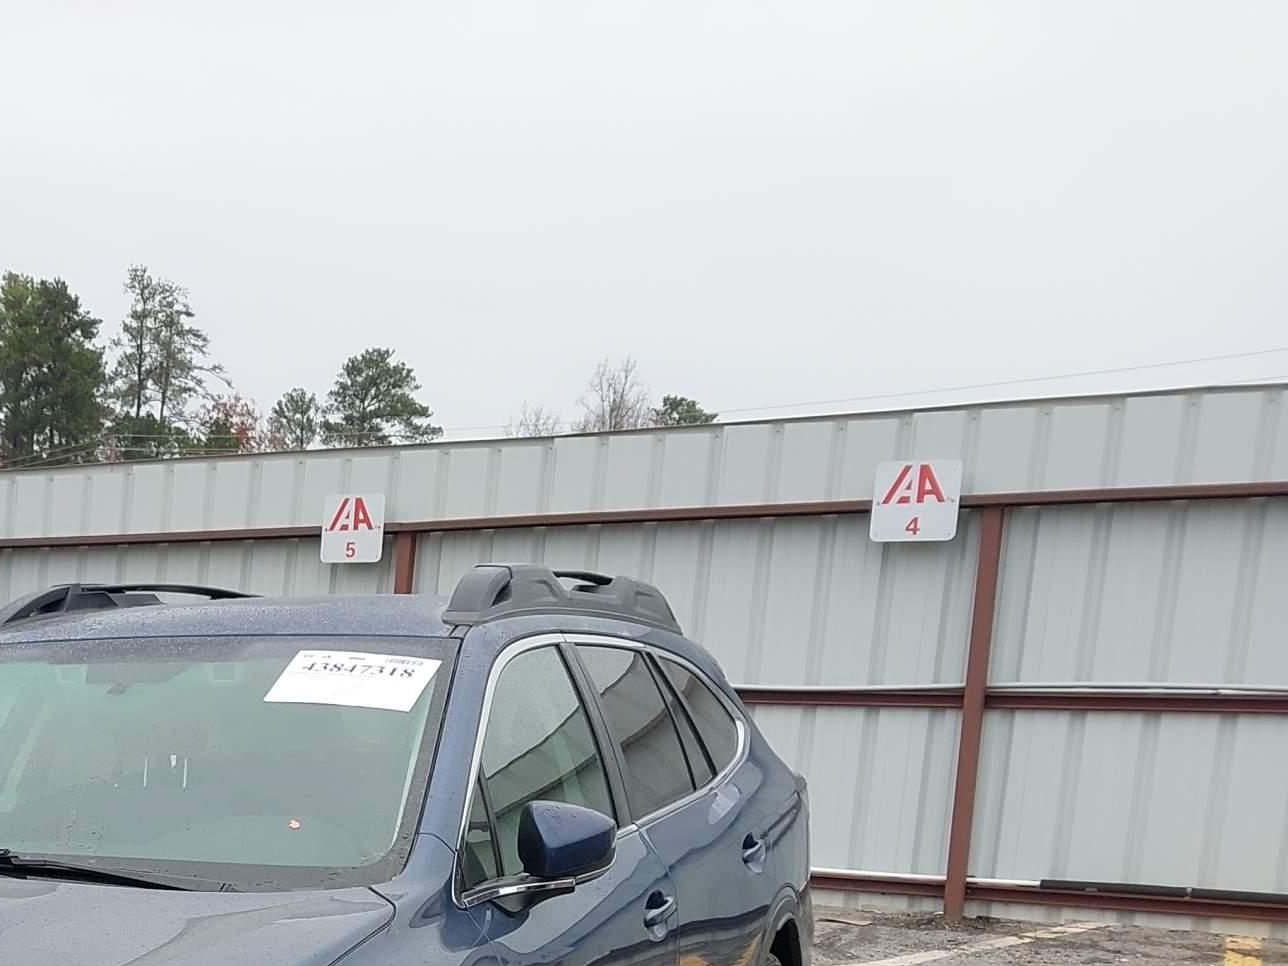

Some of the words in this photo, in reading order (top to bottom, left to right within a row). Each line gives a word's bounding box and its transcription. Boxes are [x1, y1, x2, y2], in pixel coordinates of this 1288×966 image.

[904, 516, 921, 536] 4
[345, 541, 357, 559] 5
[302, 661, 416, 679] 43847318
